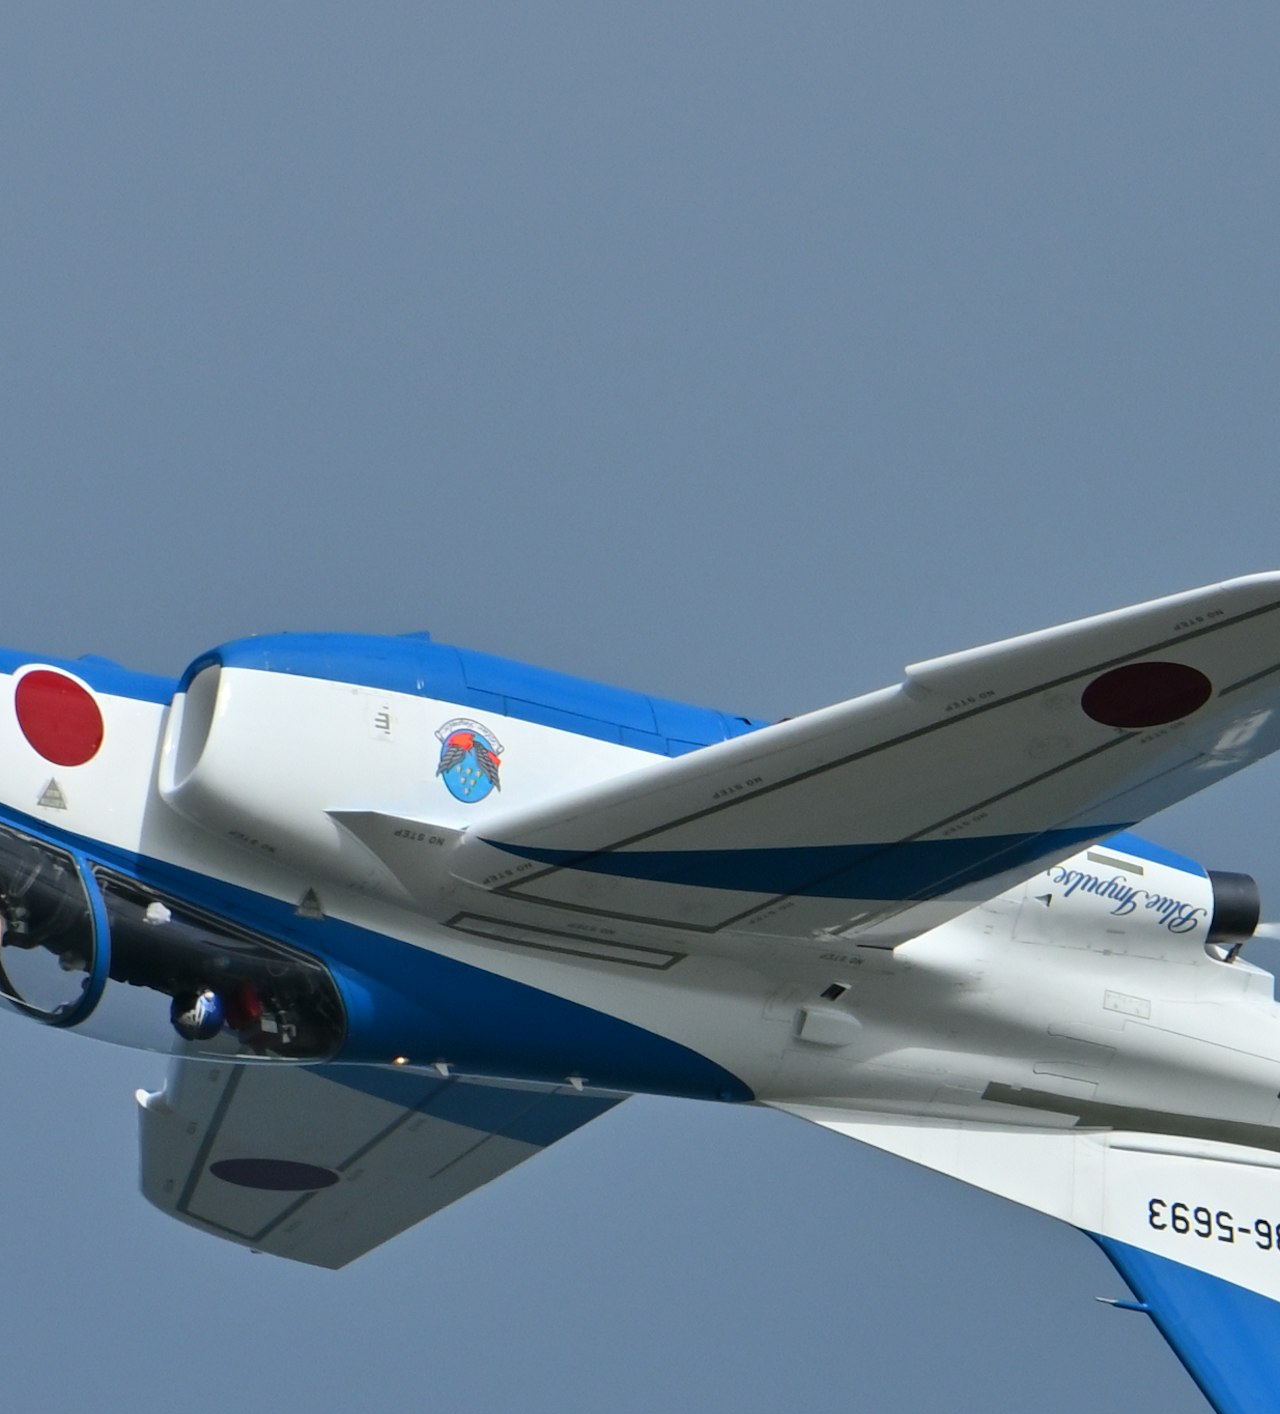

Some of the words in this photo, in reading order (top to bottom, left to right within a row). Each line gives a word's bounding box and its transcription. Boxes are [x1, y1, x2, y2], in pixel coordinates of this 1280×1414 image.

[1207, 609, 1224, 619] NO
[1173, 616, 1203, 631] STEP
[979, 690, 995, 699] NO
[945, 697, 975, 711] STEP
[746, 777, 763, 786] NO
[713, 784, 743, 800] STEP
[394, 829, 426, 842] STEP
[429, 836, 445, 846] NO
[516, 862, 533, 872] NO
[483, 870, 513, 885] STEP
[1046, 867, 1149, 916] Impulse
[1145, 893, 1208, 934] Blue
